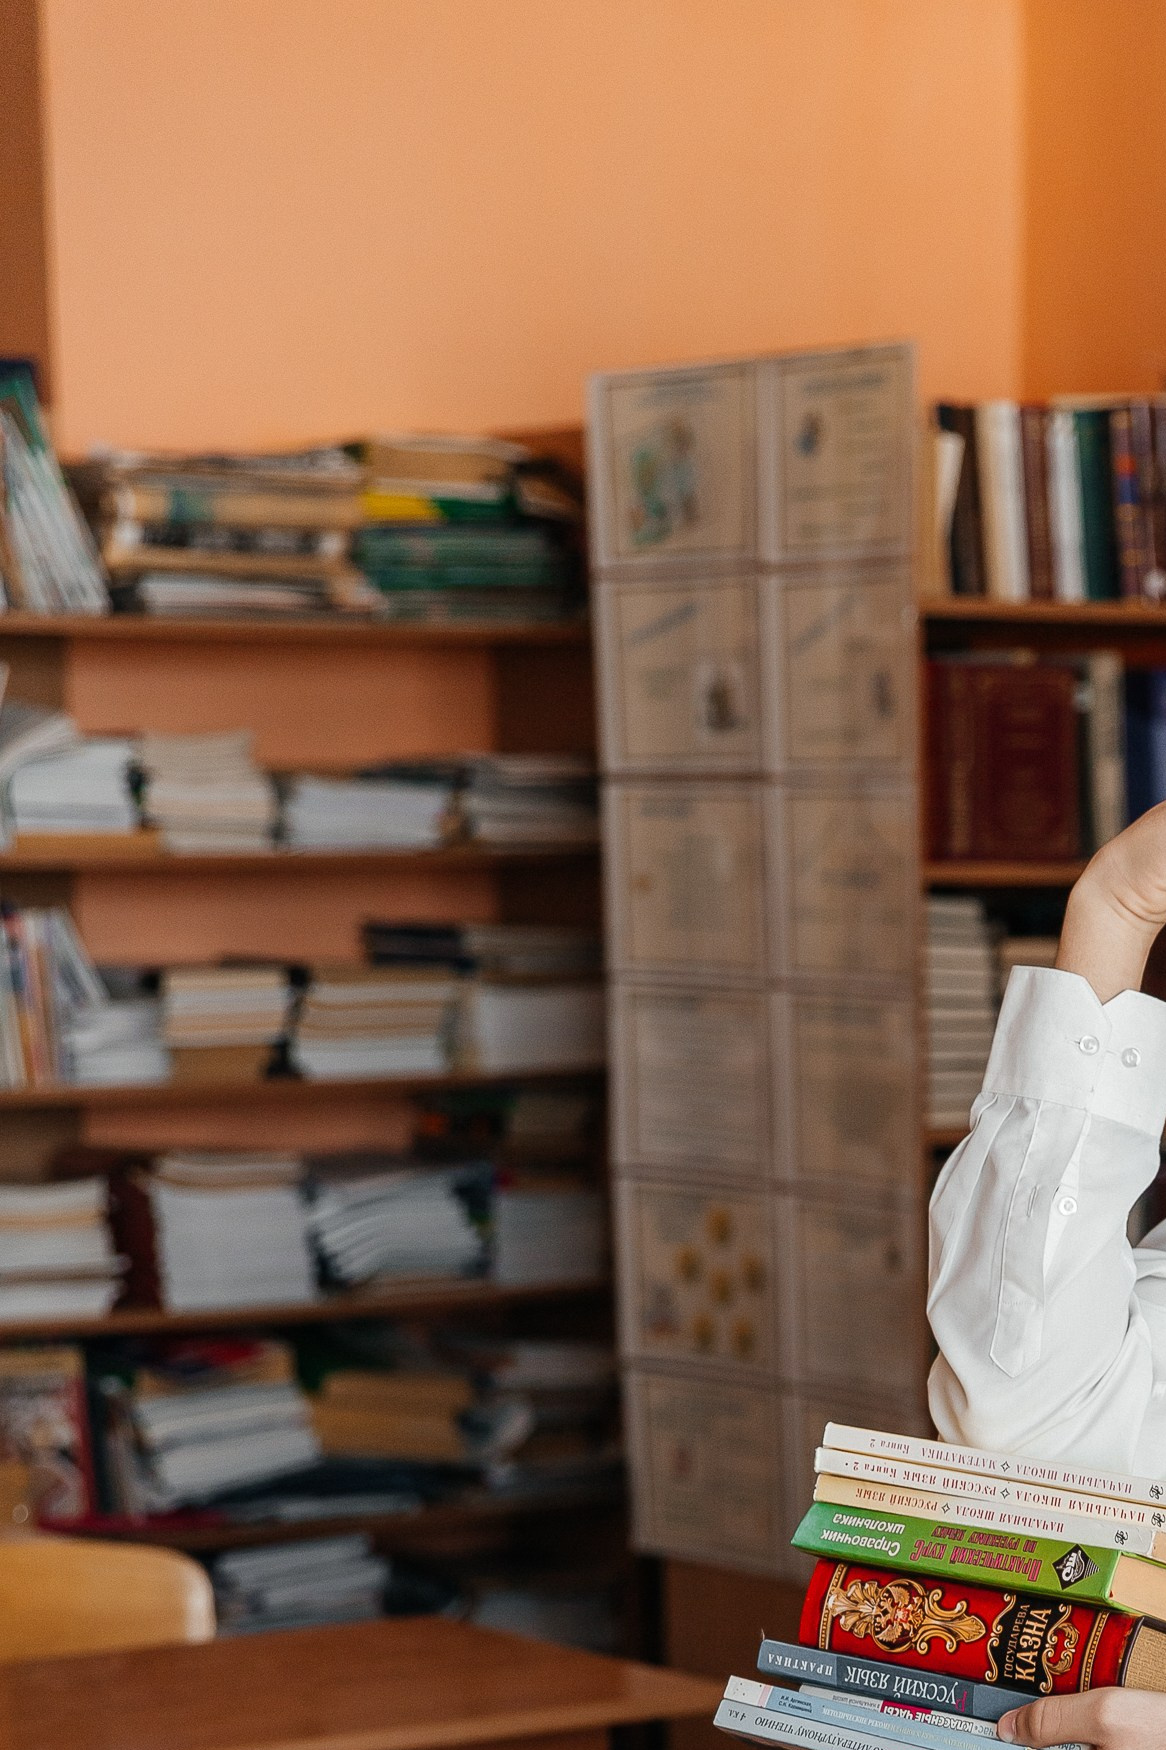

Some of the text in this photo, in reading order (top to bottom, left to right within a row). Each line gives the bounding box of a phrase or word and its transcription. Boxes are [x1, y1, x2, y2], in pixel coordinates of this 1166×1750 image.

[870, 1438, 997, 1470] МАТЕМАТИКА Книга 2
[853, 1461, 997, 1496] РУССКИЙ ЯЗЫК Книга 2
[1016, 1464, 1133, 1494] НАЧАЛЬНАЯ ШКОЛА
[855, 1487, 938, 1511] РУССКИЙ ЯЗЫК
[1016, 1490, 1146, 1523] НАЧАЛЬНАЯ ШКОЛА
[832, 1513, 905, 1535] школьника
[955, 1505, 1065, 1533] НАЧАЛЬНАЯ ШКОЛА
[820, 1529, 901, 1557] Справочник
[1003, 1604, 1030, 1678] ГОСУДАРЕВА
[1015, 1608, 1052, 1682] КАЗНА
[768, 1653, 833, 1676] ПРАКТИКА
[893, 1675, 967, 1713] Русский
[755, 1716, 793, 1735] ЧТЕНИЮ
[883, 1705, 973, 1733] КЛАССНЫЕ ЧАСЫ
